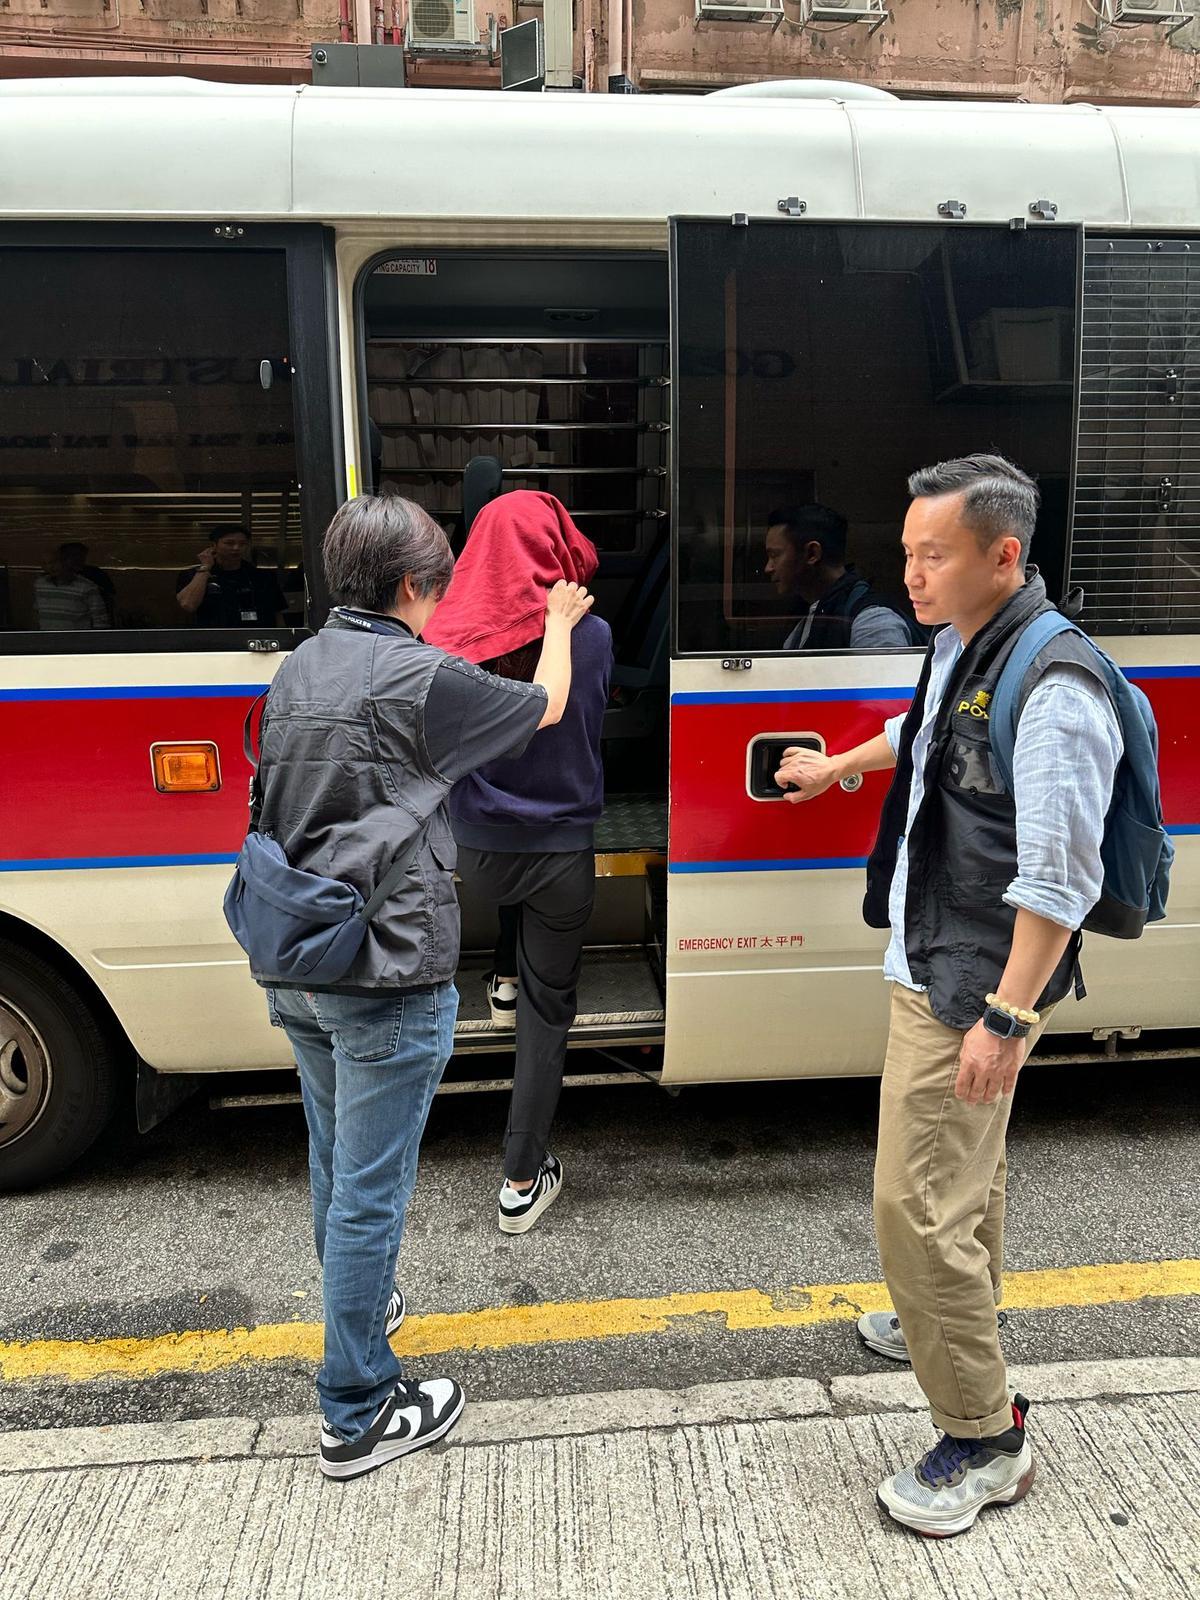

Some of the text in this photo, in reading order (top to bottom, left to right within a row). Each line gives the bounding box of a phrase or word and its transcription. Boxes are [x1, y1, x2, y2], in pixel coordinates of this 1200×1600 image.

[390, 263, 420, 273] CAPACITY
[348, 616, 362, 625] POLICE
[679, 935, 804, 951] EMERGENCY EXIT 太平門
